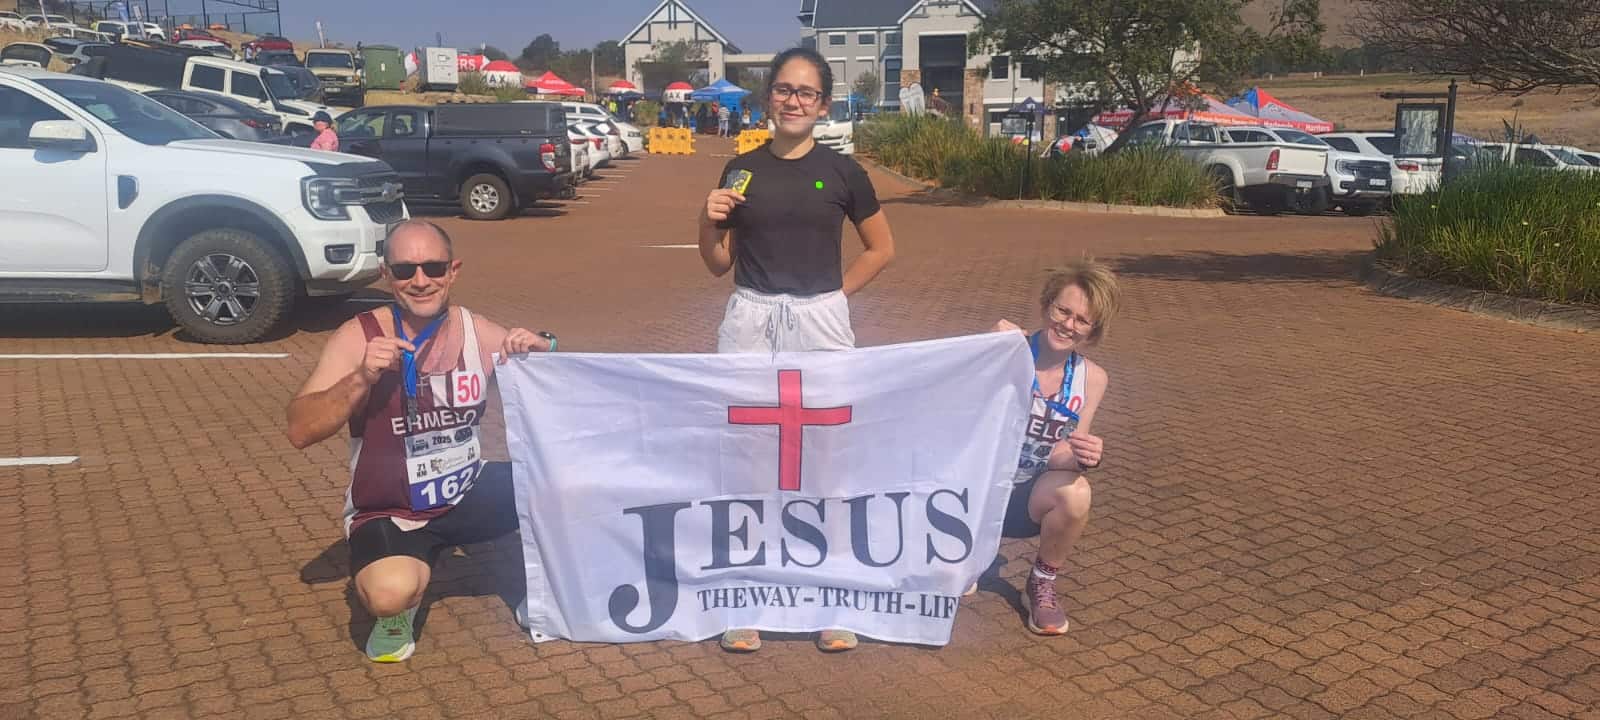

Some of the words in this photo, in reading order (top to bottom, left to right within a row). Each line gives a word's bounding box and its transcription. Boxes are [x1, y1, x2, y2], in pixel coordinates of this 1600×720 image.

[457, 373, 481, 403] 50
[391, 409, 477, 436] ERMELO
[431, 435, 452, 446] 2025
[416, 463, 426, 472] 71
[416, 470, 428, 478] KM
[608, 487, 973, 635] JESUS
